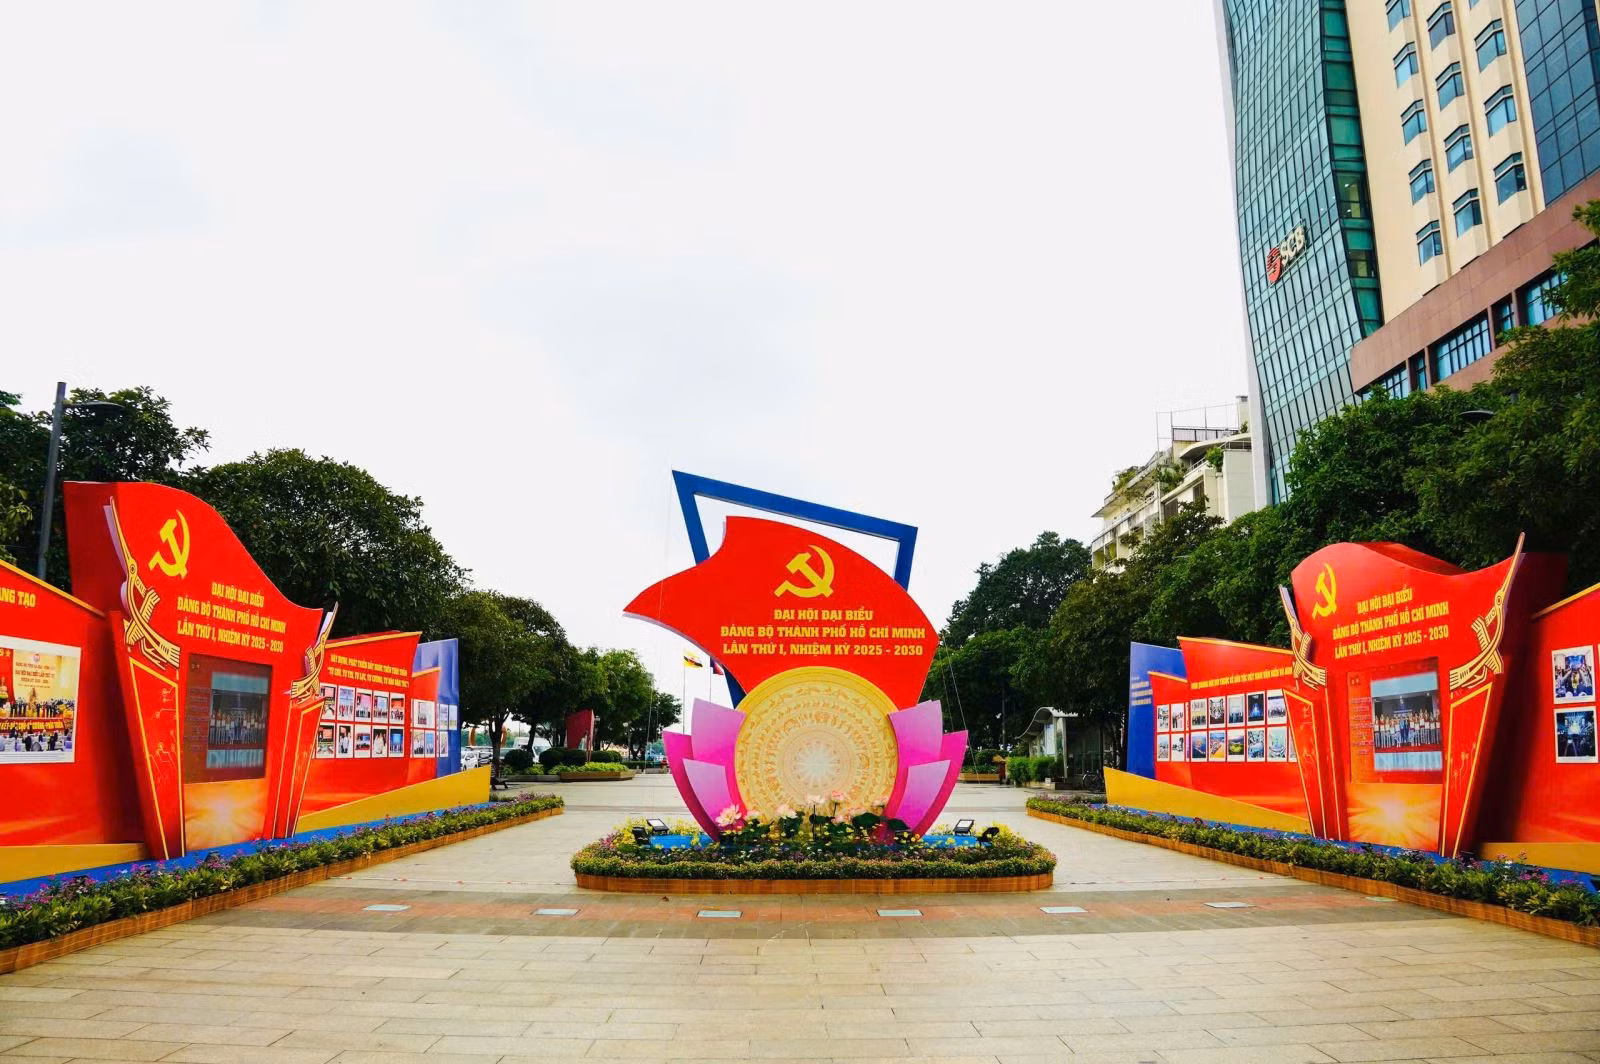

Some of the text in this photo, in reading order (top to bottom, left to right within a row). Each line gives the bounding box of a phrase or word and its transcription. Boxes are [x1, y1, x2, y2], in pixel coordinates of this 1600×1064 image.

[1280, 225, 1305, 267] SCB
[0, 586, 36, 608] NG TẠO
[774, 606, 873, 622] ĐẠI HỘI ĐẠI BIỂU
[1425, 601, 1449, 619] MINH
[720, 624, 925, 639] ĐẢNG BỘ THÀNH PHỐ HỒ CHÍ MINH
[1403, 630, 1422, 646] 2025
[1428, 625, 1448, 640] 2030
[723, 640, 748, 654] LẦN
[751, 641, 777, 655] THỨ
[790, 642, 831, 657] NHIỆM
[834, 642, 850, 655] KỲ
[853, 645, 882, 656] 2025
[894, 645, 923, 656] 2030
